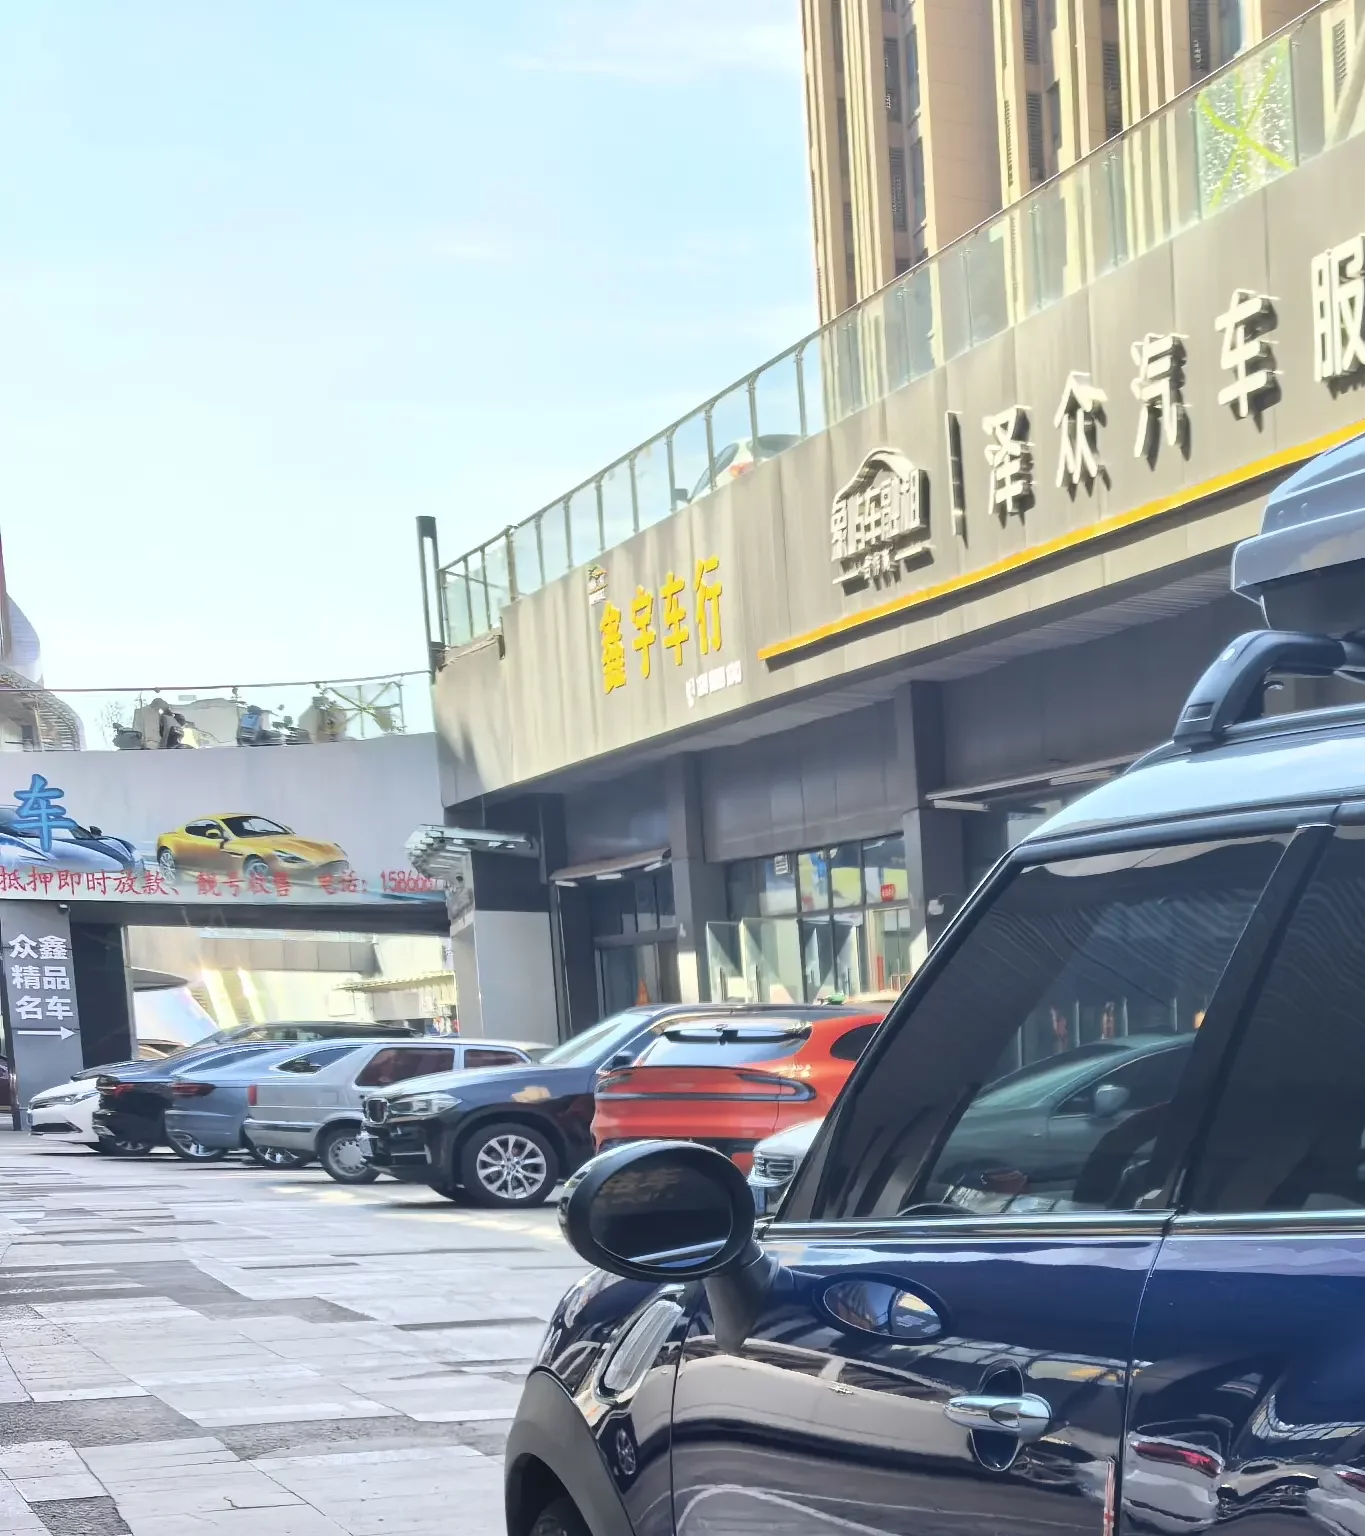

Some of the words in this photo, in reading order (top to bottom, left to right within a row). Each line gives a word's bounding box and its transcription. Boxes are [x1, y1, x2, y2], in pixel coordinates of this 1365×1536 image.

[13, 773, 78, 852] 车
[8, 933, 69, 960] 众鑫
[11, 964, 71, 990] 精品
[15, 995, 75, 1020] 名车
